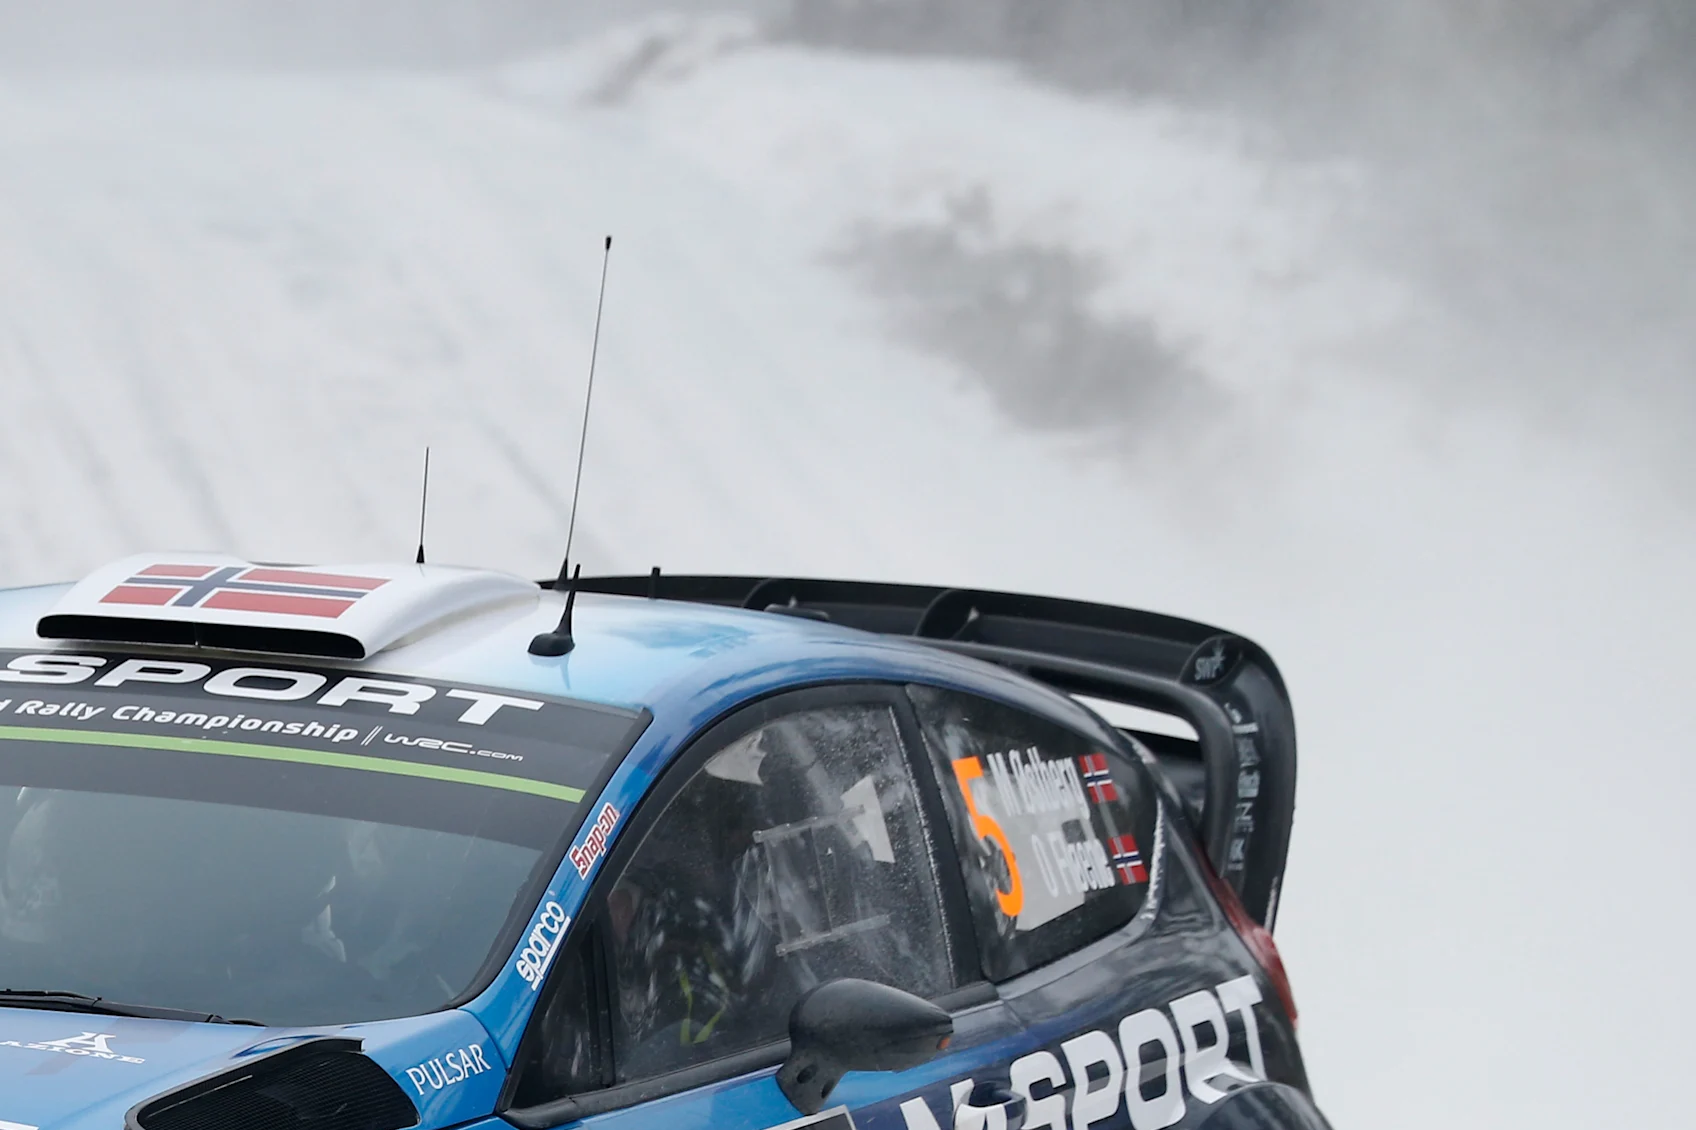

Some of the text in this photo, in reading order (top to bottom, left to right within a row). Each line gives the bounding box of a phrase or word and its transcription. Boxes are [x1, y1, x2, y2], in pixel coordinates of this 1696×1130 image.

[15, 699, 106, 720] Rally
[112, 705, 359, 743] Championship
[951, 755, 1024, 917] 5
[516, 900, 568, 984] sparco
[405, 1043, 492, 1095] PULSAR
